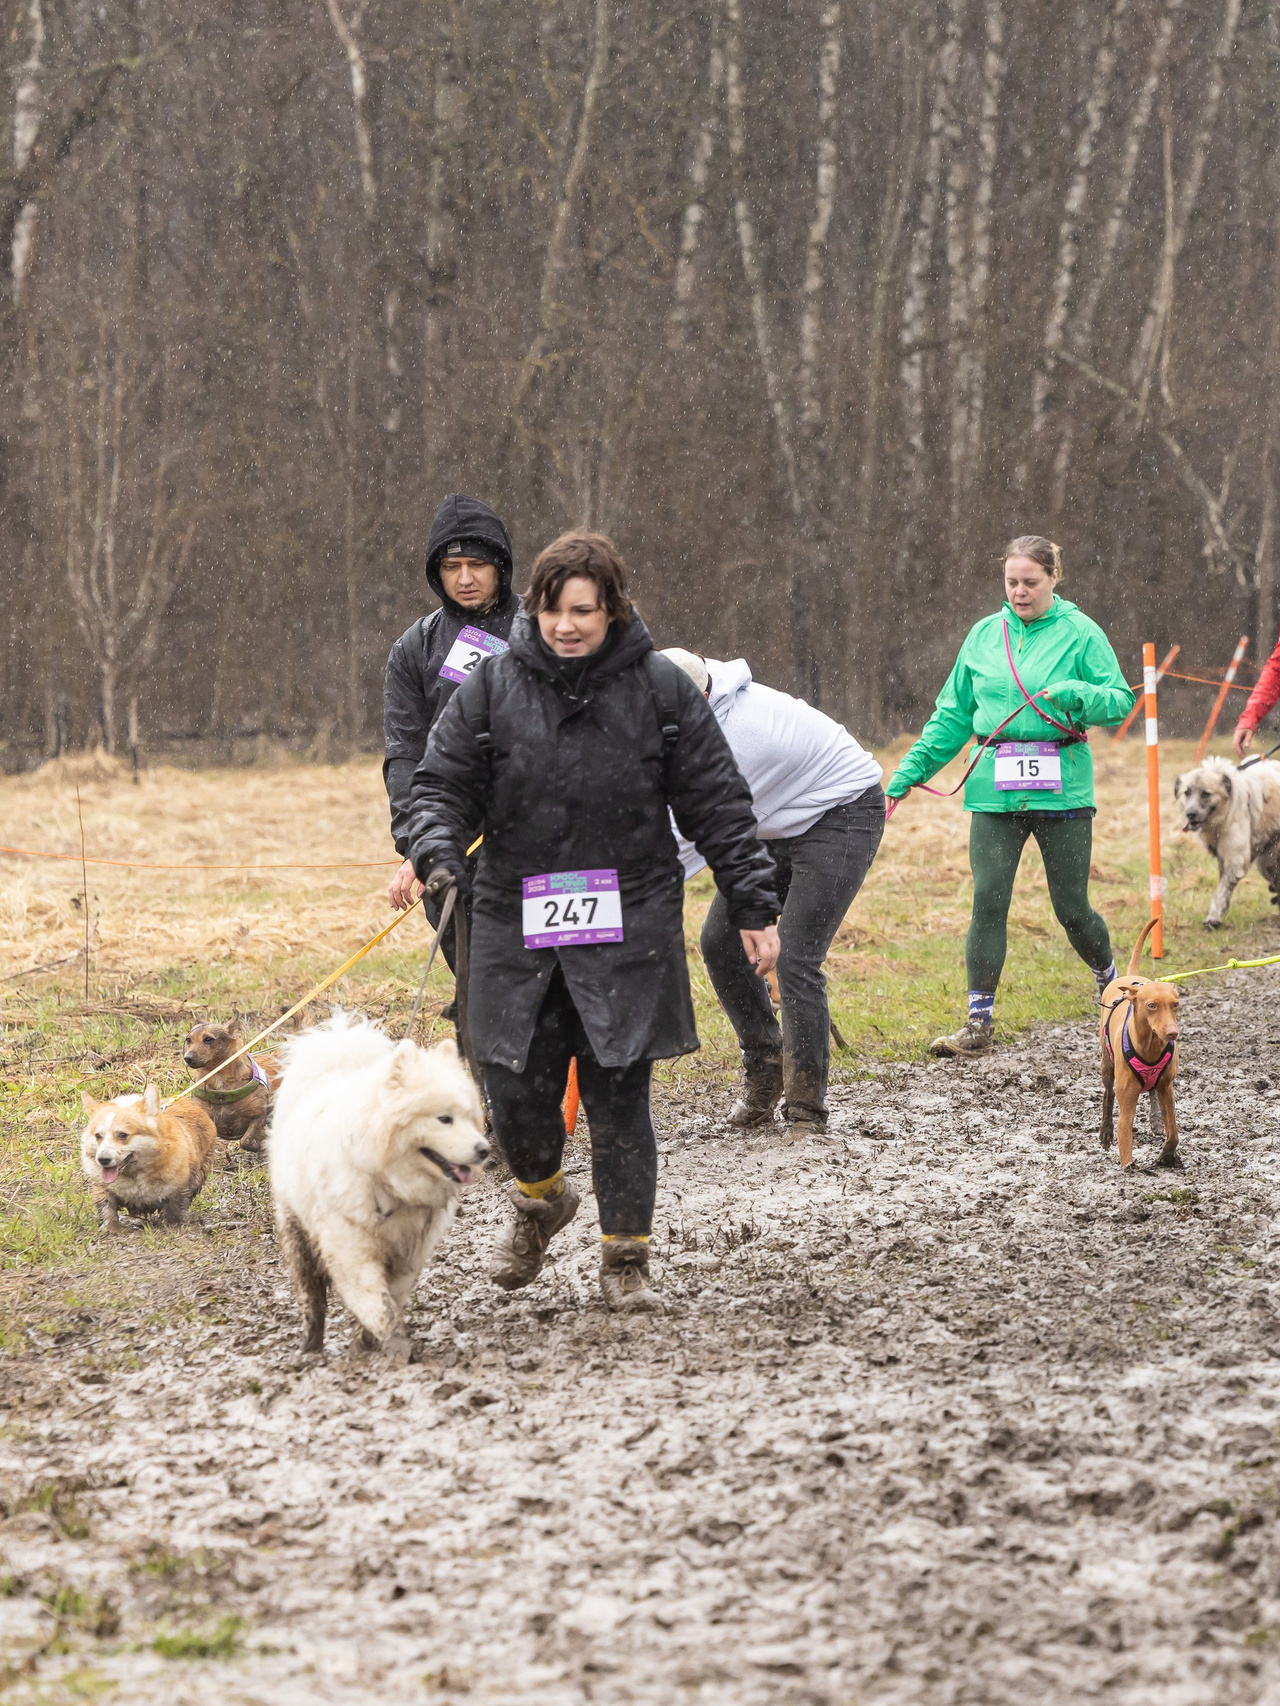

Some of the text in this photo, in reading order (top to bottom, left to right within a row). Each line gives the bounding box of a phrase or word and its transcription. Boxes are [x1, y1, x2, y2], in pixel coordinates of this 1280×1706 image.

[463, 632, 480, 643] 2026
[1016, 760, 1040, 777] 15
[544, 897, 598, 927] 247
